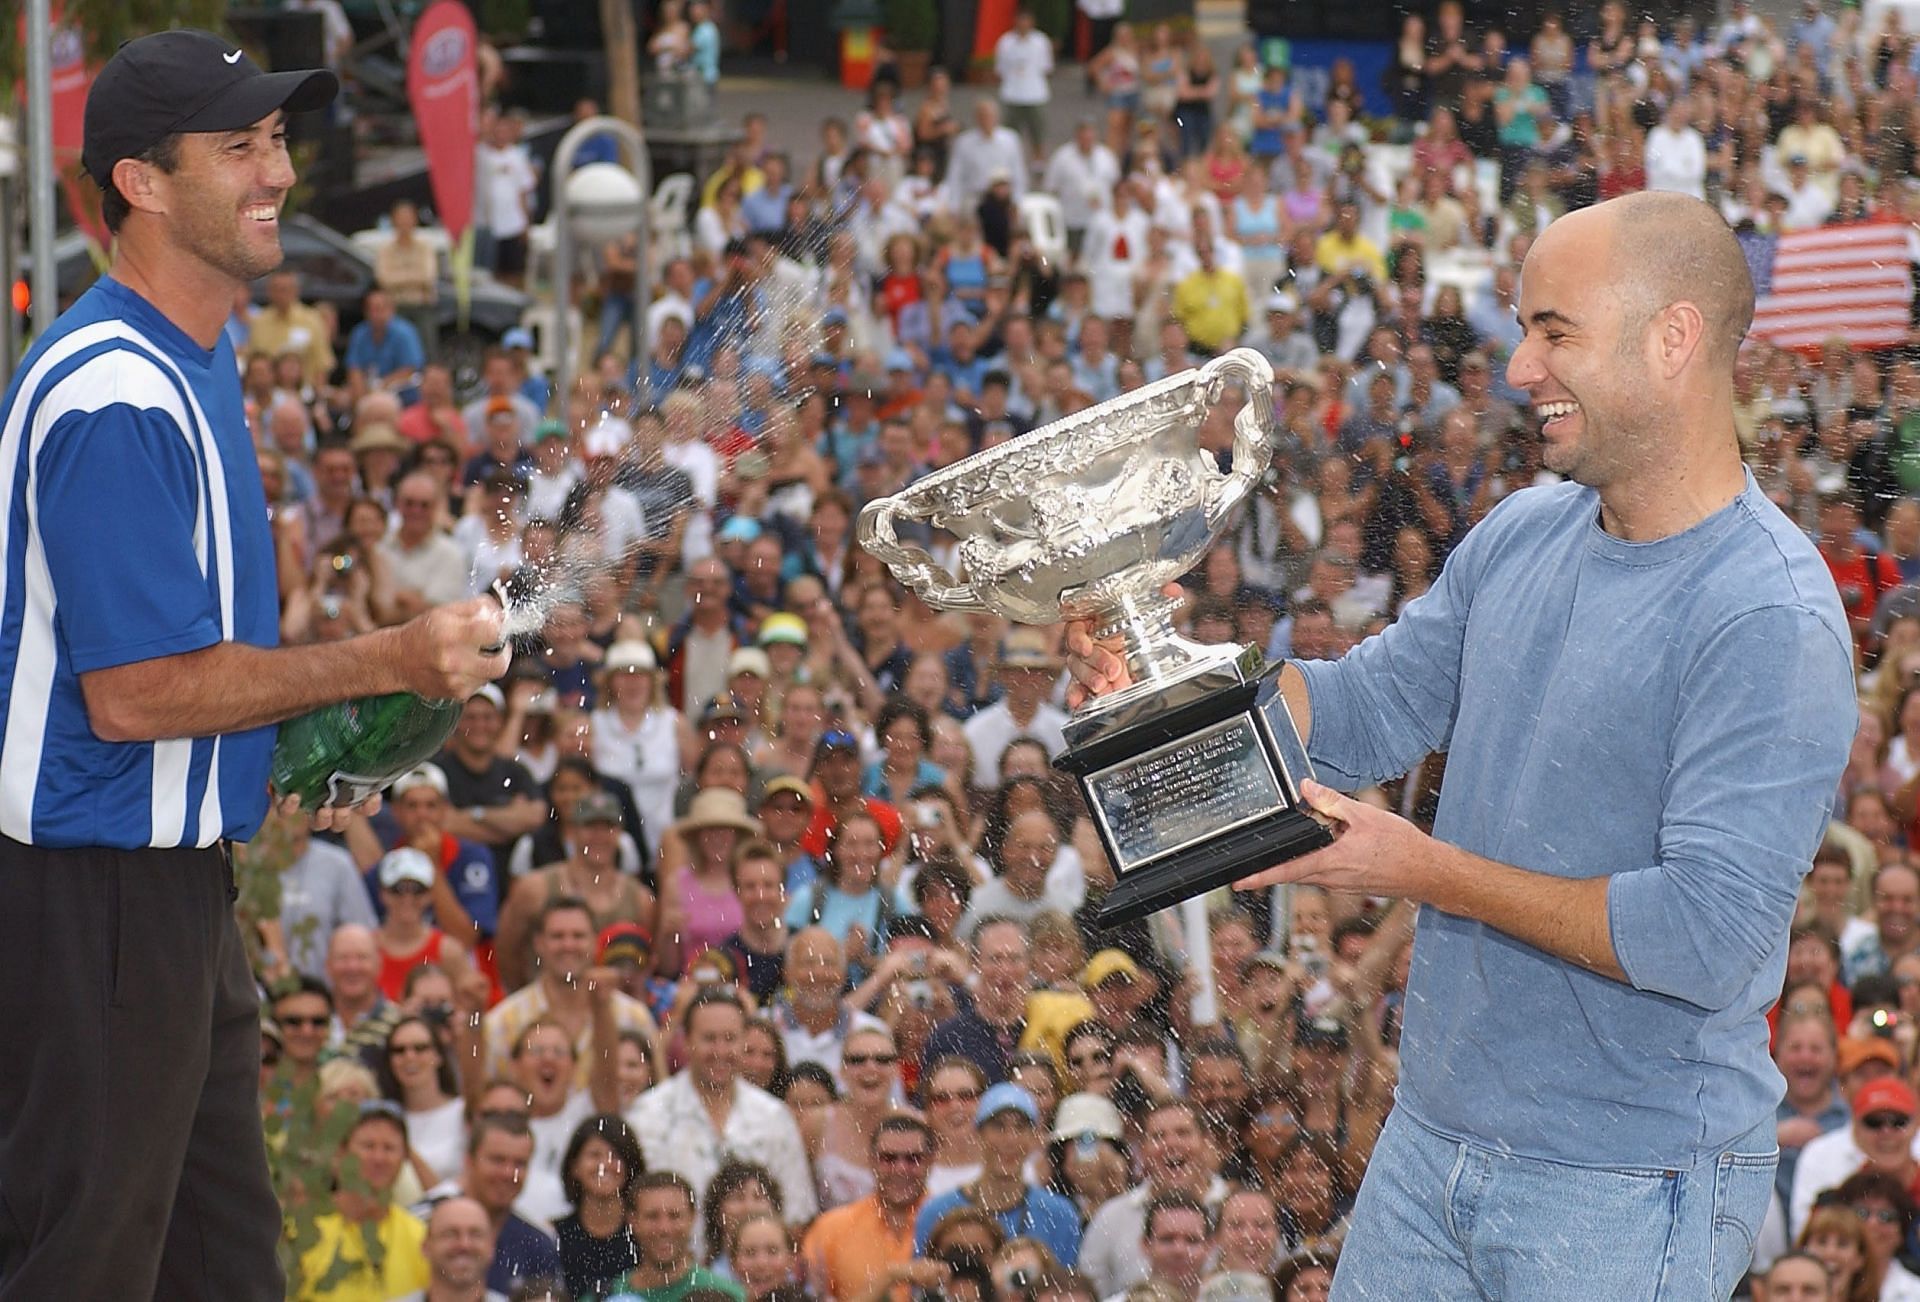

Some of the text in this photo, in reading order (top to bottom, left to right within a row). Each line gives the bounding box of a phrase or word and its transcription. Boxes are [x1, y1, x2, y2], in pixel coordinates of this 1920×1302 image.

[1138, 755, 1176, 775] BROOKES
[1176, 735, 1225, 760] CHALLENGE
[1225, 728, 1243, 741] CUP
[1140, 759, 1192, 785] CHAMPIONSHIP
[1193, 755, 1201, 764] OF
[1203, 739, 1242, 760] AUSTRALIA
